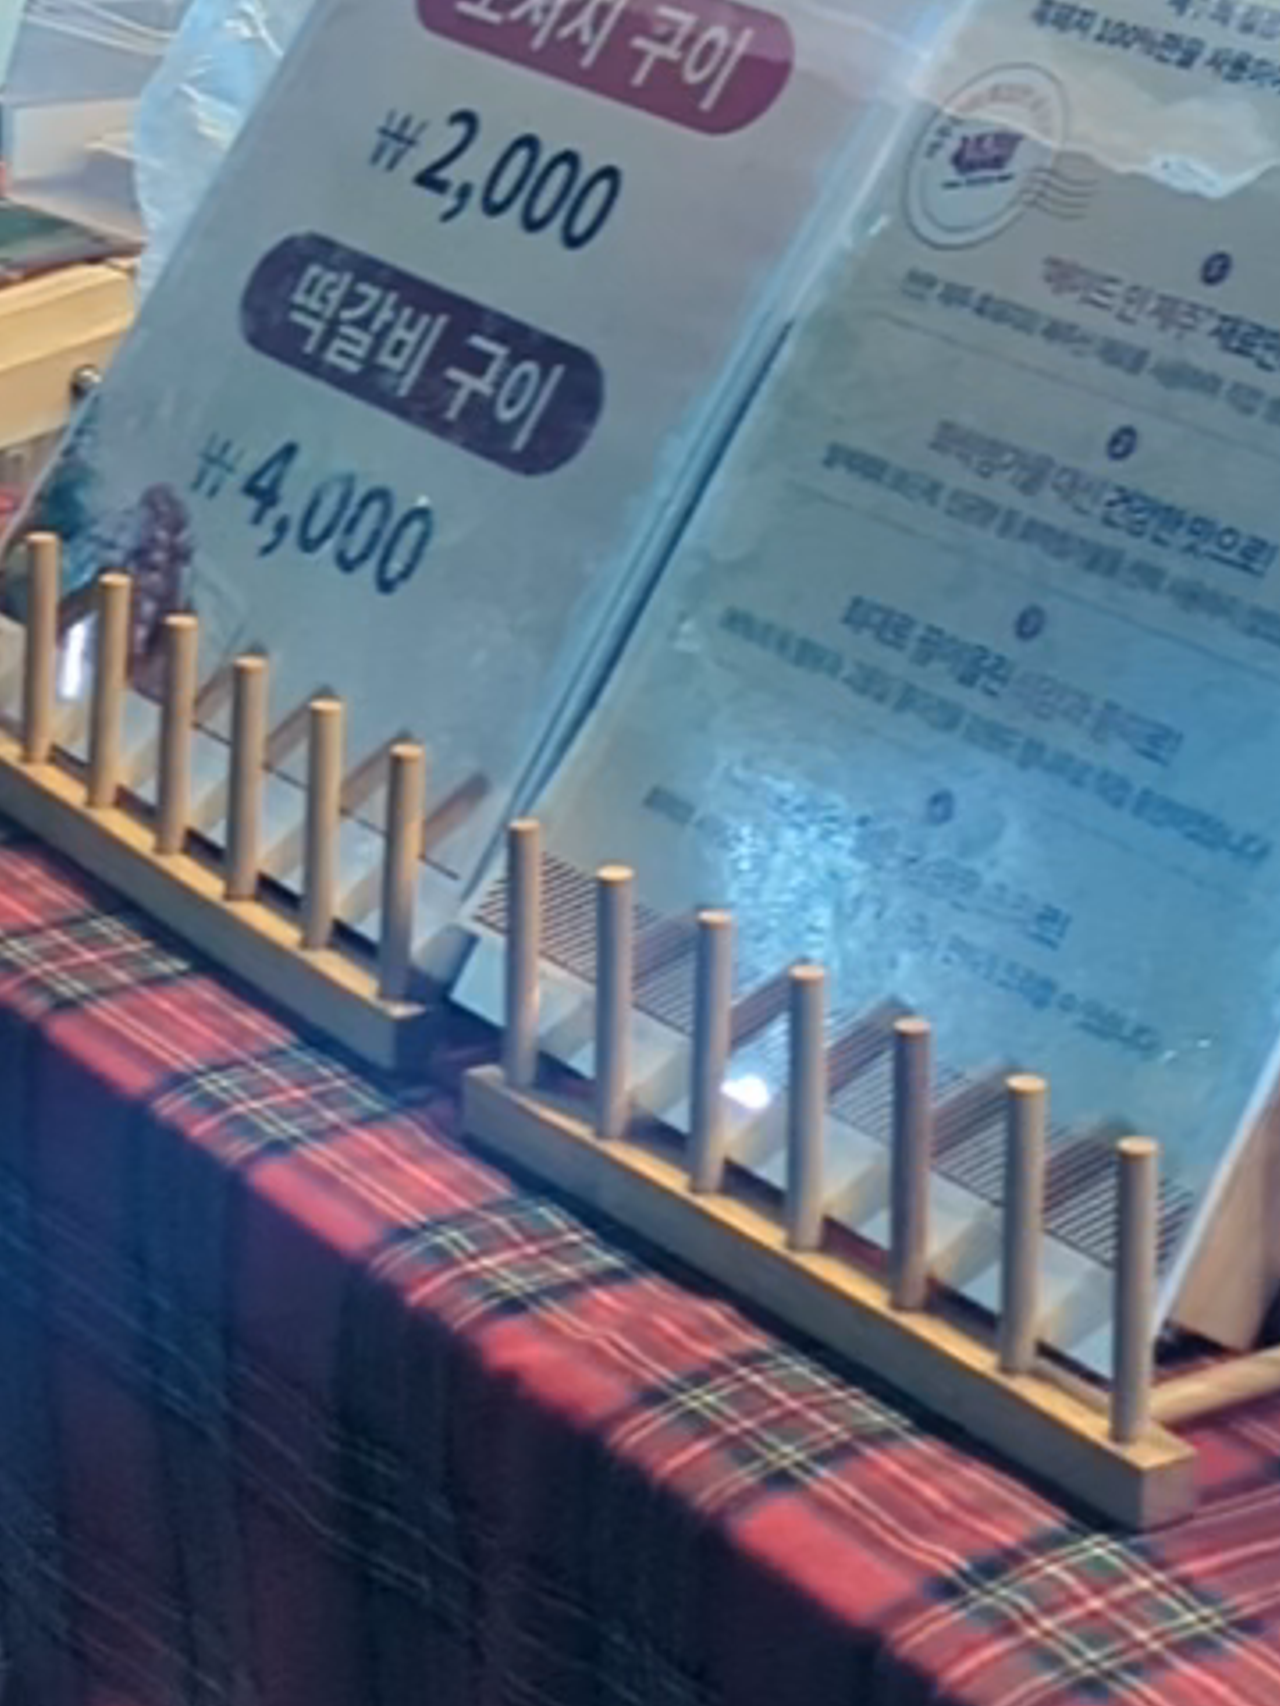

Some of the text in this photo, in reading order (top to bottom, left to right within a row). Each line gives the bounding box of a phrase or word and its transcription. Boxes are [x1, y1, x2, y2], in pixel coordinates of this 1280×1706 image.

[630, 4, 757, 113] 구이
[369, 106, 626, 252] ₩2,000
[287, 265, 567, 452] 떡갈비 구이
[188, 436, 438, 597] ₩4,000
